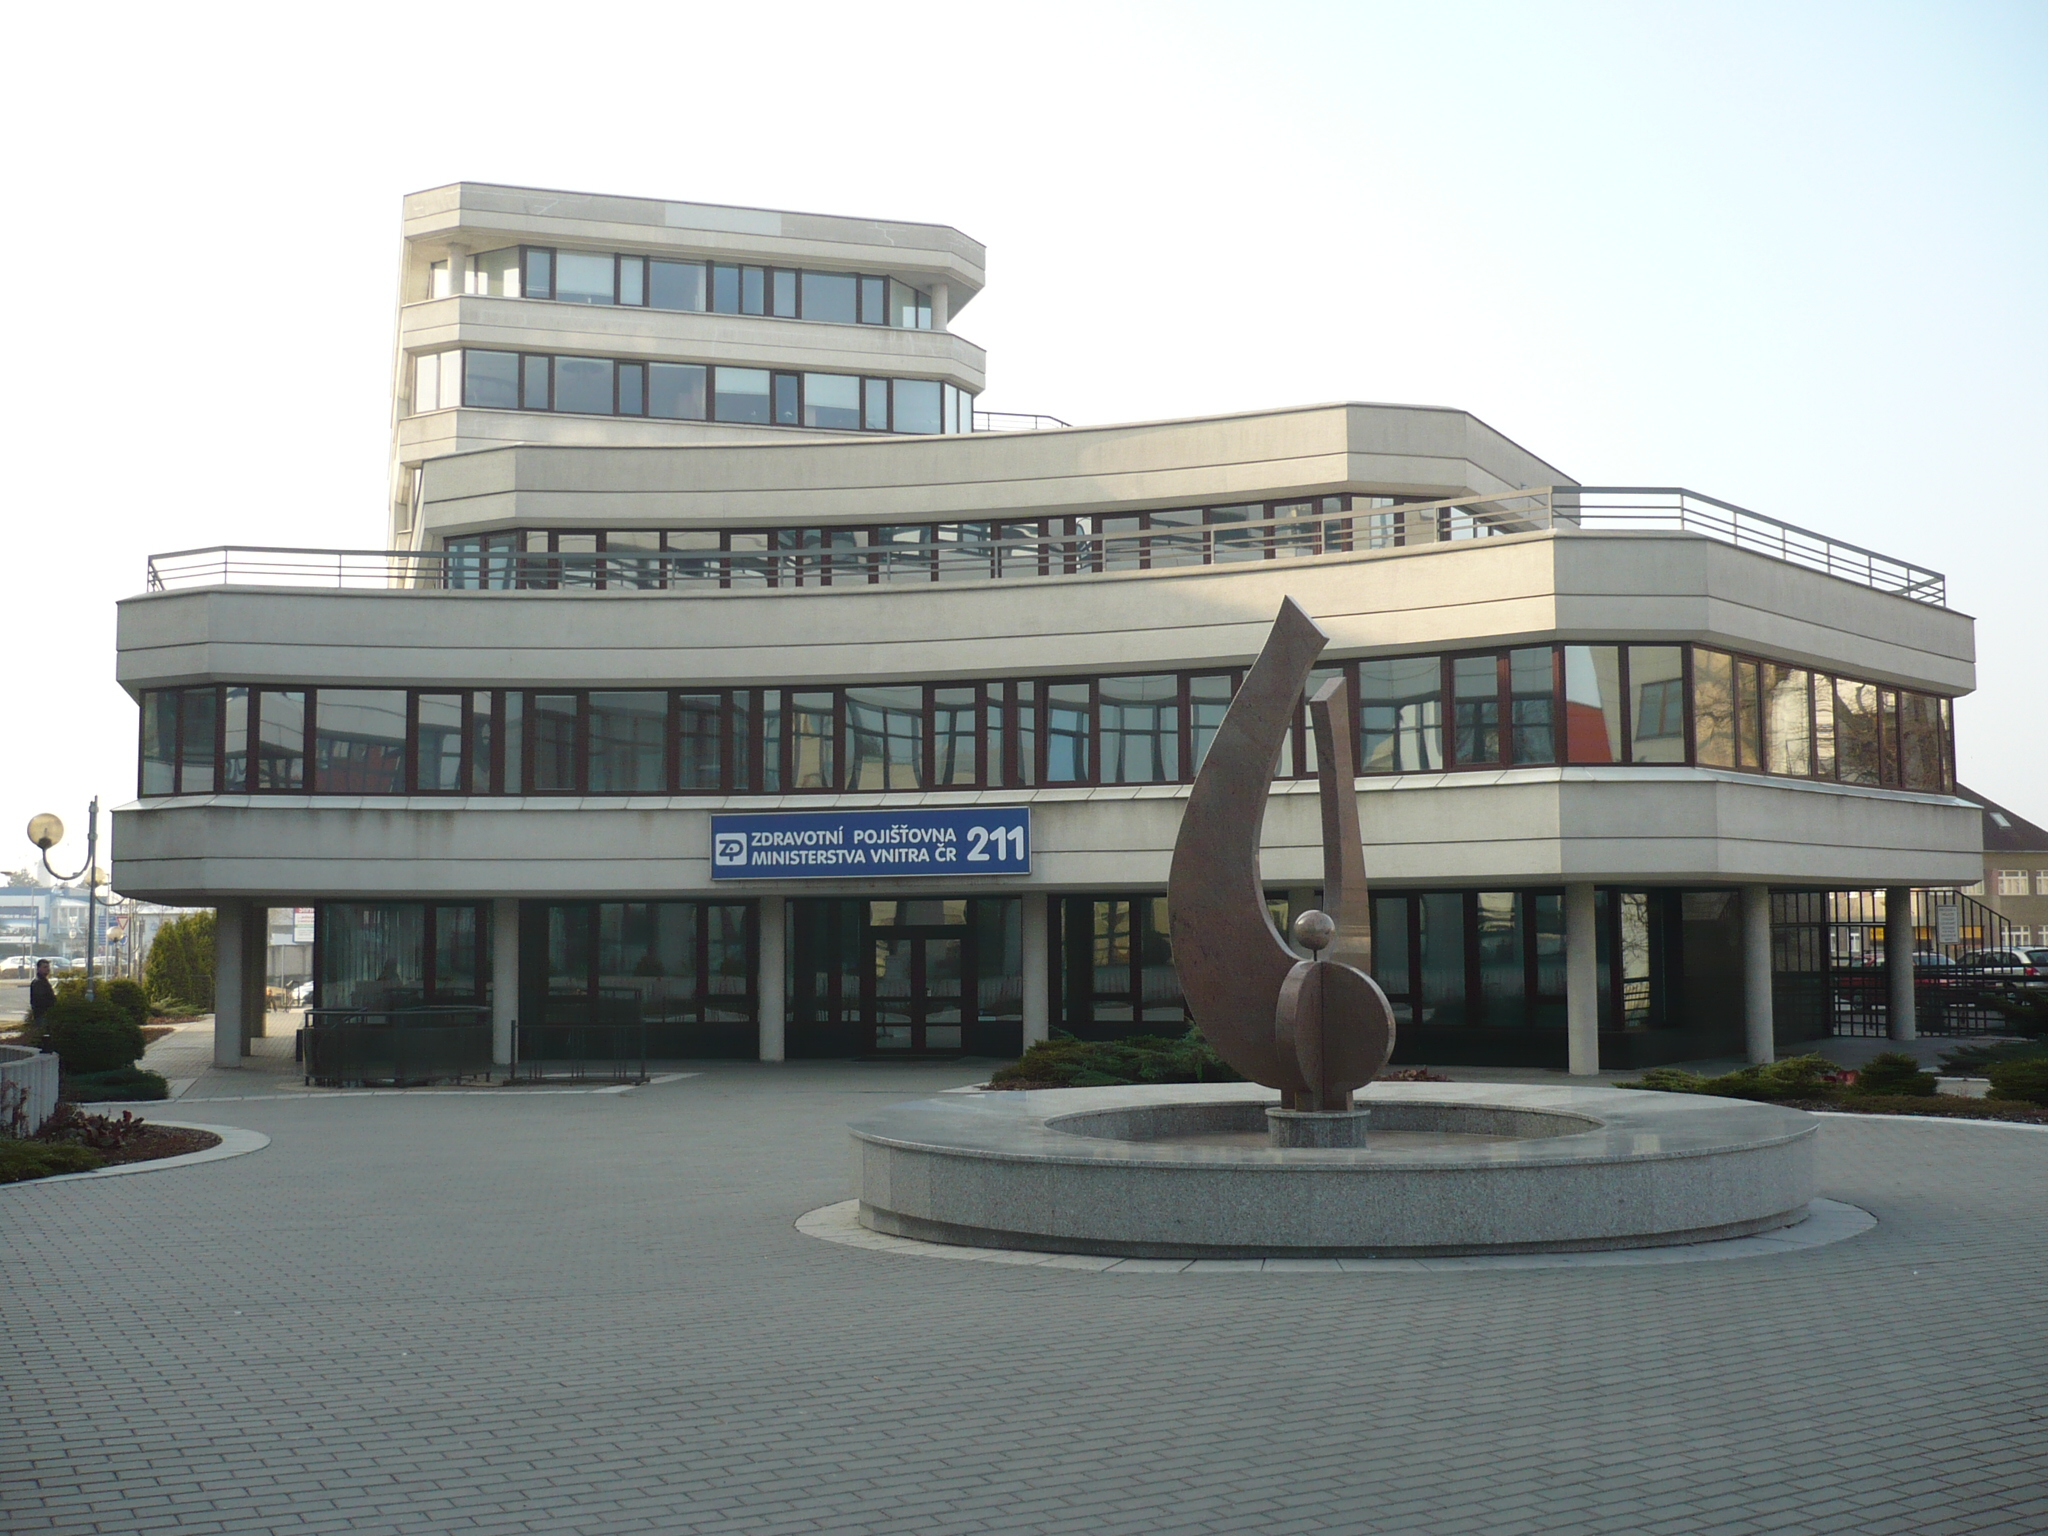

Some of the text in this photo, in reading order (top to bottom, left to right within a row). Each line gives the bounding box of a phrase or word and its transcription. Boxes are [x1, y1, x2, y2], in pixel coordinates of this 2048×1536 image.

[751, 824, 957, 846] ZDRAVOTNÍ POJIŠŤOVNA
[966, 825, 1024, 861] 211
[751, 843, 957, 866] MINISTERSTVA VNITRA ČR
